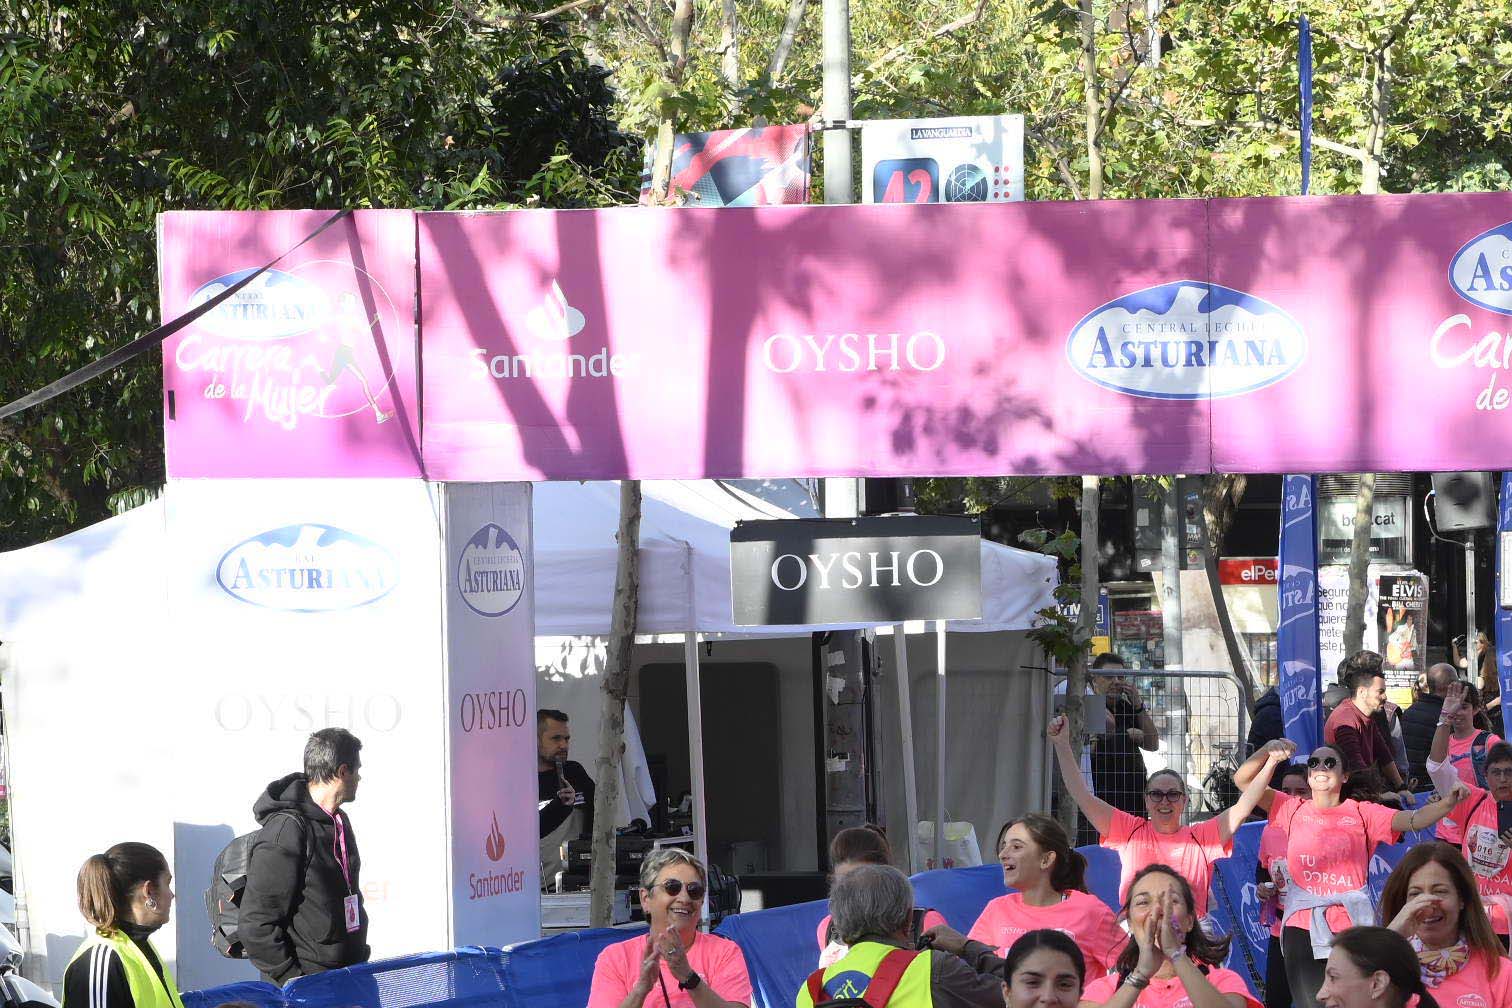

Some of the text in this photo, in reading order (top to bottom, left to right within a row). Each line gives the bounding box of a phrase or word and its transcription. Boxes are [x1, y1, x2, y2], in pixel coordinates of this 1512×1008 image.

[1122, 322, 1197, 334] CENTRAL
[176, 335, 293, 372] Carrera
[764, 333, 945, 373] OYSHO
[1087, 326, 1287, 369] ASTURIANA
[204, 368, 336, 431] de la Mujer
[1476, 372, 1510, 410] de
[464, 558, 520, 593] ASTURIANA
[772, 549, 944, 593] OYSHO
[1393, 584, 1423, 597] ELVIS
[460, 688, 526, 734] OYSHO
[1300, 854, 1315, 867] TU
[1303, 870, 1353, 887] DORSAL
[469, 868, 524, 901] Santander
